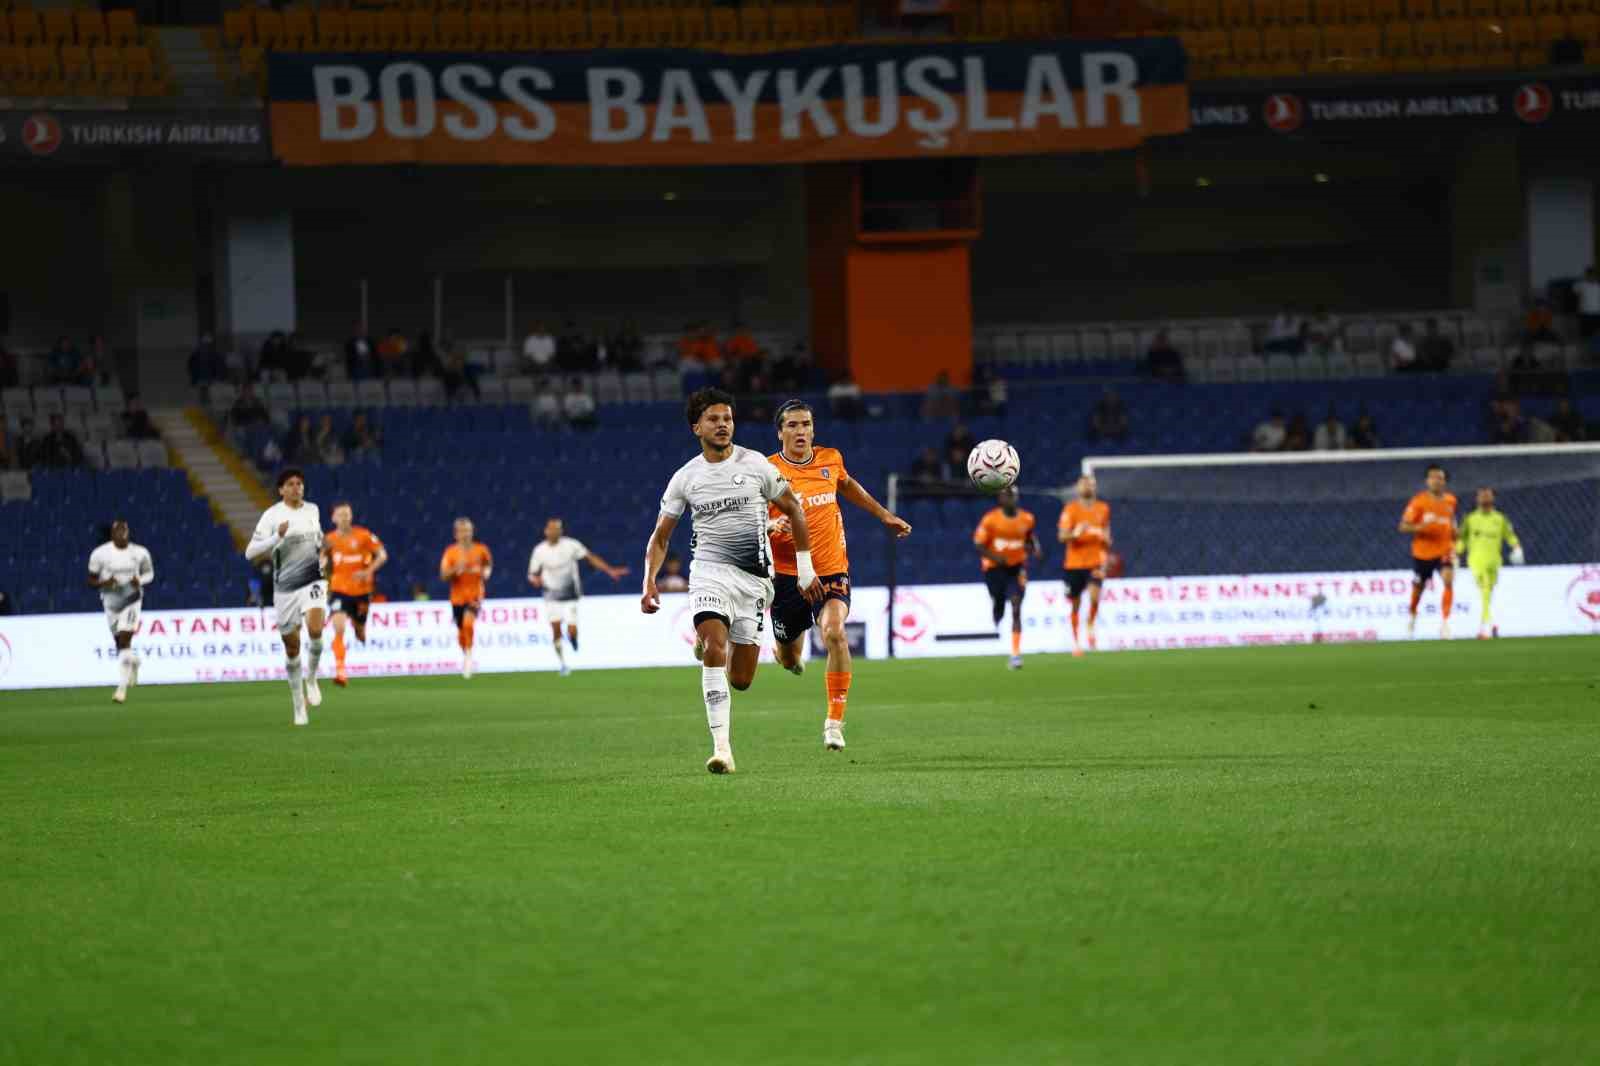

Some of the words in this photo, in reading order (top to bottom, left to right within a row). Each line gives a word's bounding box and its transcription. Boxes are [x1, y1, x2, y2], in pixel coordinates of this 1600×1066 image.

[312, 62, 558, 143] BOSS
[586, 50, 1142, 151] BAYKUŞLAR
[1311, 98, 1399, 120] TURKISH
[1406, 94, 1499, 117] AIRLINES
[70, 124, 162, 144] TURKISH
[167, 124, 261, 144] AIRLINES
